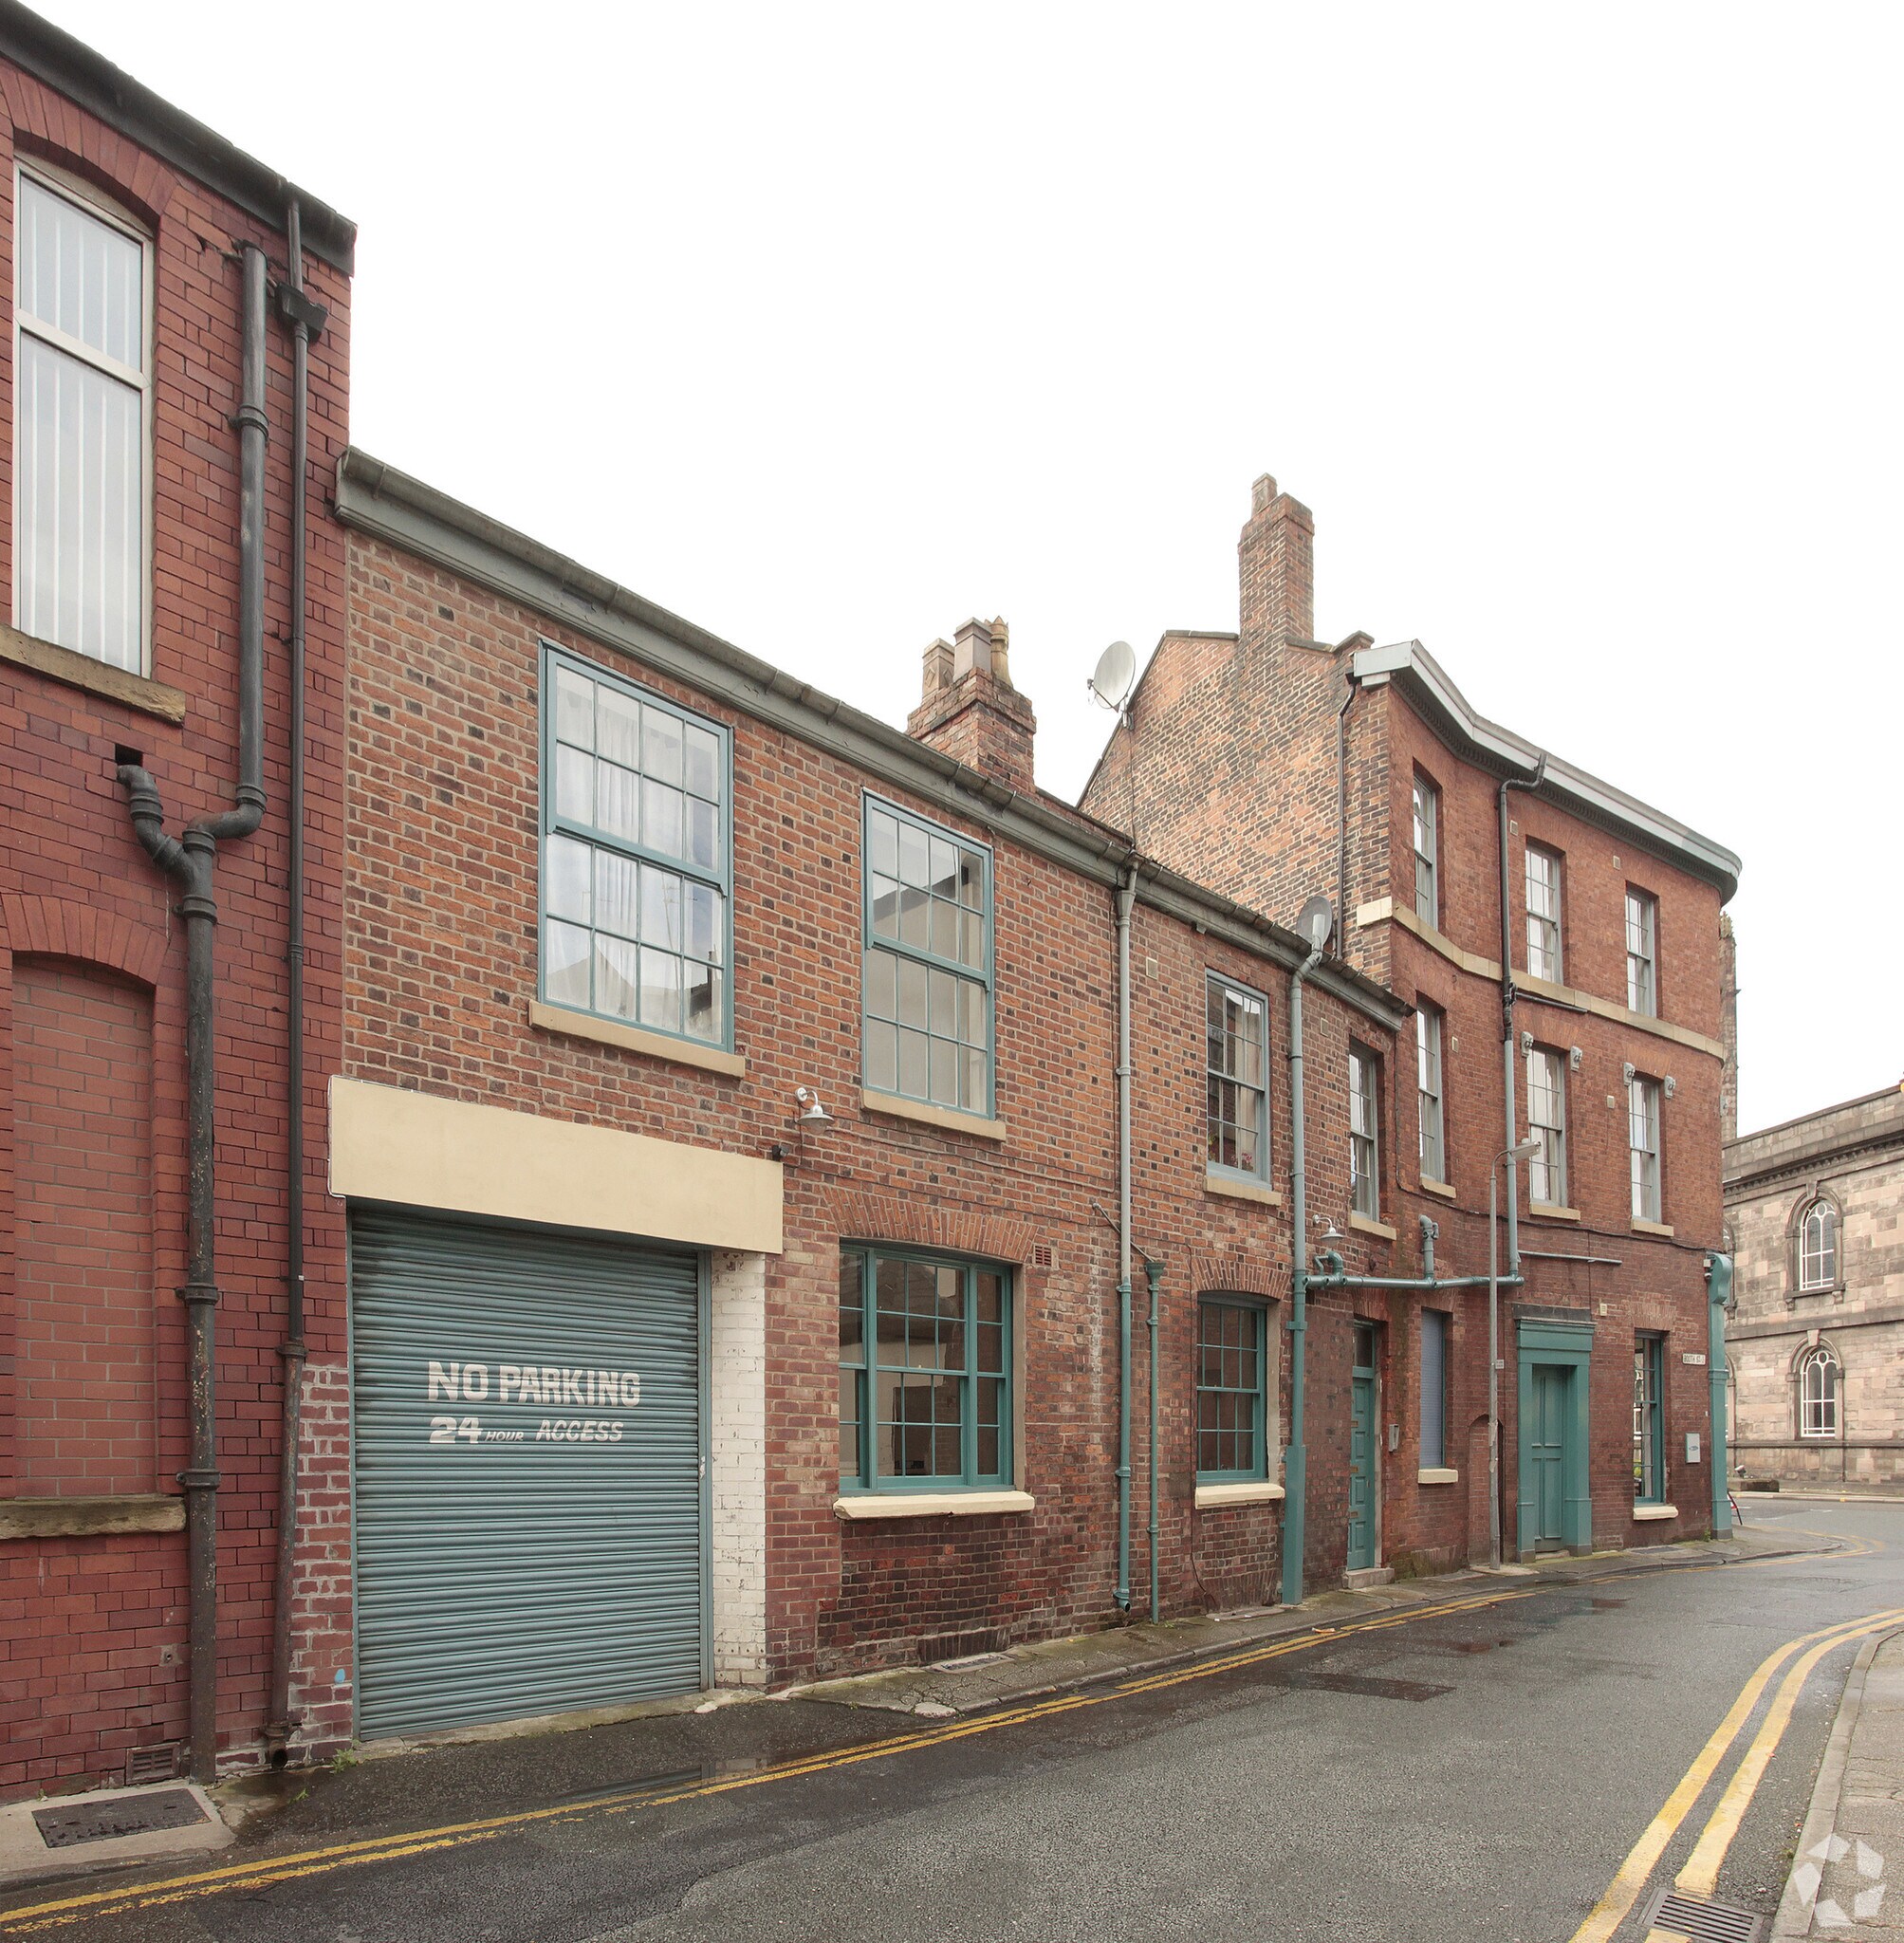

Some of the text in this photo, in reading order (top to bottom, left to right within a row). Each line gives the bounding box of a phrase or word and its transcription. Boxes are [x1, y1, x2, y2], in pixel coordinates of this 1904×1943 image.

[428, 1361, 640, 1407] NO PARKING
[430, 1416, 624, 1444] 24 HOUR ACCESS
